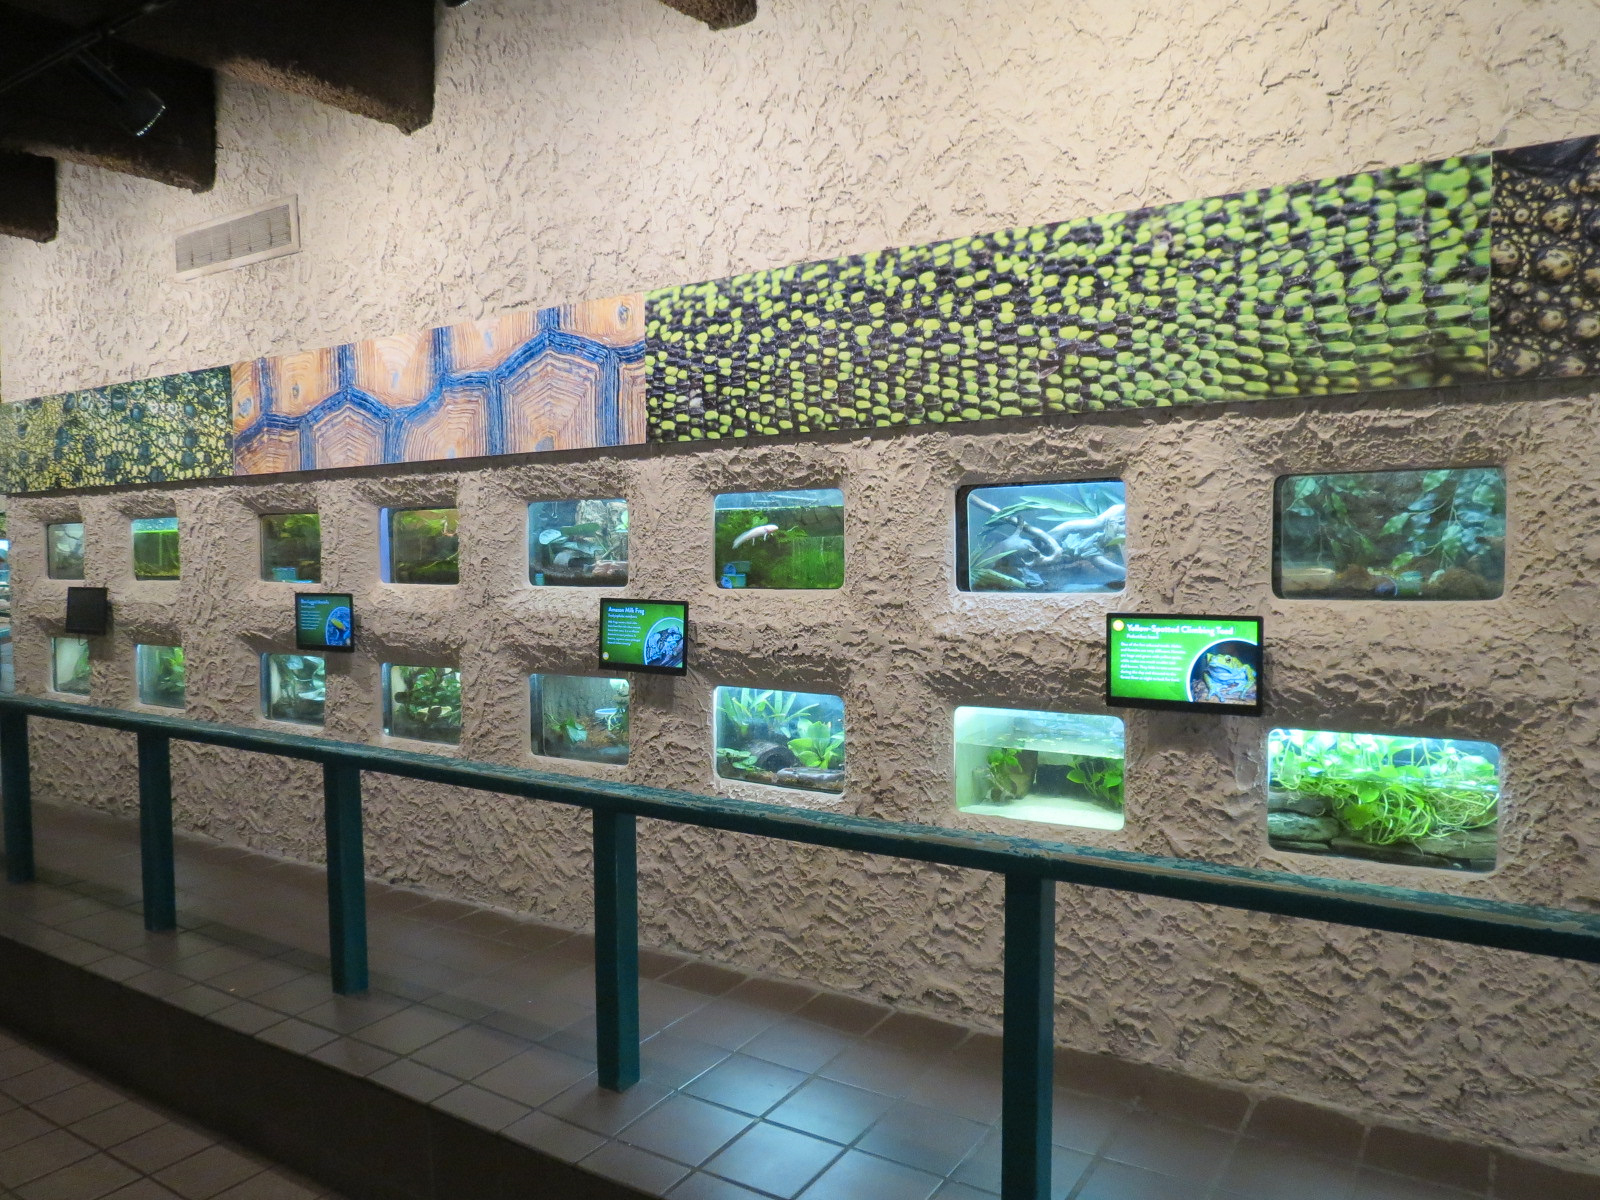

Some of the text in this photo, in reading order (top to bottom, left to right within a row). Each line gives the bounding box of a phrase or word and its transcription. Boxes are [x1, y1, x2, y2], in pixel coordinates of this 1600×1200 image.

[635, 607, 645, 616] Frog
[1126, 623, 1234, 637] Yellow-Spotted Climbing Toad
